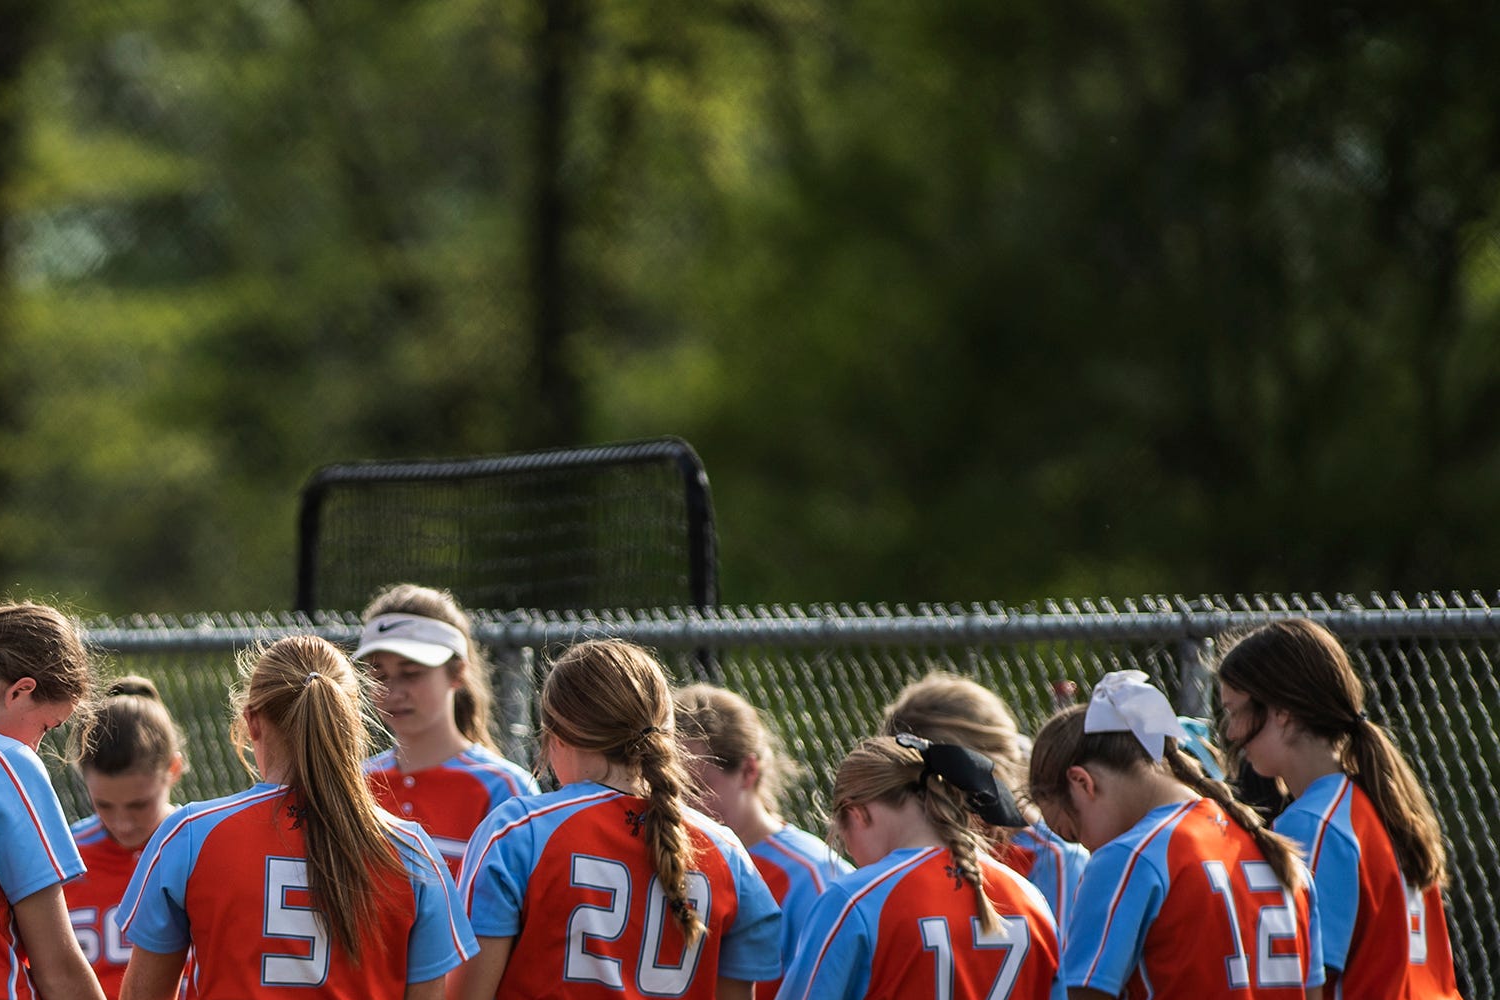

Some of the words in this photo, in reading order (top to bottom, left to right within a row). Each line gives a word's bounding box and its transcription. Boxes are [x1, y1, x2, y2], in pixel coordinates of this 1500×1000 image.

[260, 854, 331, 988] 5
[564, 853, 711, 998] 20
[1203, 859, 1303, 989] 12
